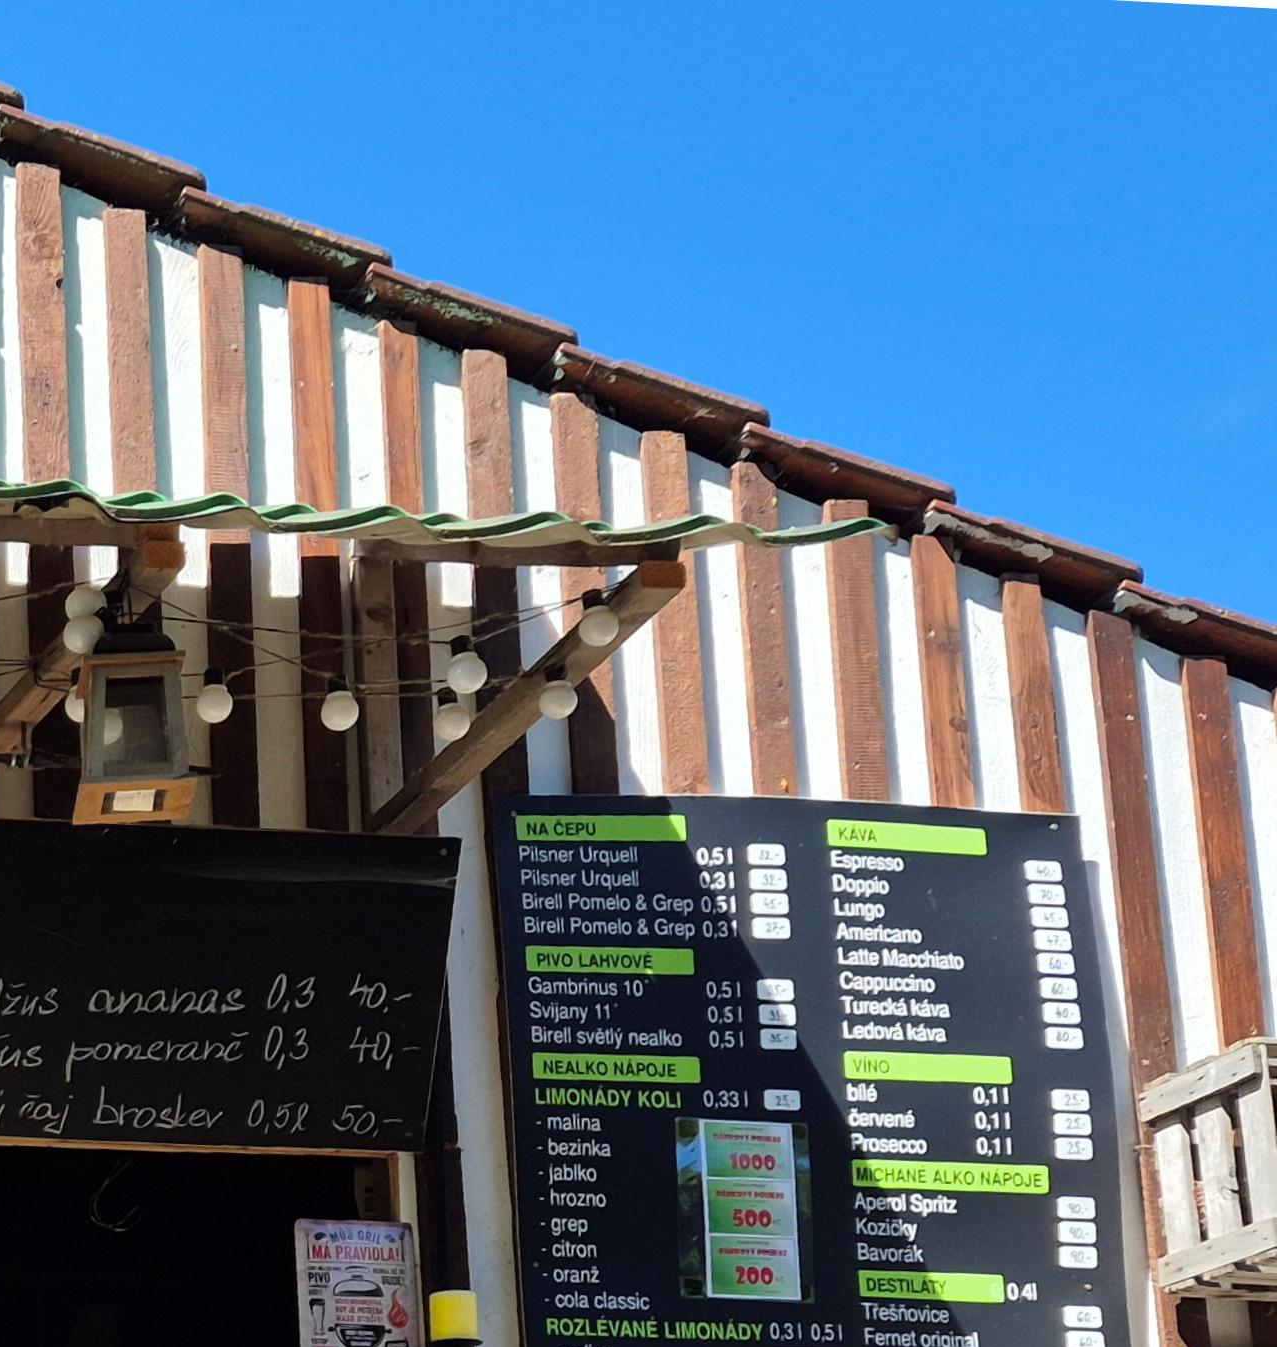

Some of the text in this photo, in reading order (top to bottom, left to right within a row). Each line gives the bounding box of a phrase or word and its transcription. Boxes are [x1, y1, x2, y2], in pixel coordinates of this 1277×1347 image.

[527, 820, 596, 836] NA ČEPU
[839, 825, 877, 842] KÁVA
[519, 846, 637, 866] Pilsner Urquell
[830, 850, 904, 873] Espresso
[832, 874, 889, 897] Doppio
[522, 893, 562, 909] Birell
[569, 893, 630, 910] Pomelo
[653, 894, 693, 916] Grep
[834, 898, 885, 921] Lungo
[836, 922, 922, 943] Americano
[537, 953, 573, 967] PIVO
[837, 947, 964, 970] Latte Macchiato
[528, 976, 617, 995] Gambrinus
[839, 971, 935, 994] Cappuccino
[87, 985, 246, 1016] ananas
[266, 971, 317, 1012] 0,3
[530, 1001, 588, 1024] Svijany
[840, 996, 950, 1018] Turecká káva
[263, 1025, 310, 1071] 0,3
[543, 1059, 676, 1077] NEALKO NÁPOJE
[853, 1059, 889, 1073] VÍNO
[535, 1088, 631, 1106] LIMONÁDY
[548, 1114, 601, 1131] malina
[851, 1133, 927, 1154] Prosecco
[857, 1164, 1043, 1188] MÍCHANÉ ALKO NÁPOJE
[855, 1193, 957, 1217] Aperol Spritz
[733, 1209, 773, 1228] 500
[553, 1240, 597, 1258] citron
[735, 1267, 775, 1286] 200
[866, 1275, 946, 1295] DESTILÁTY
[547, 1316, 762, 1340] ROZLÉVANÉ LIMONÁDY
